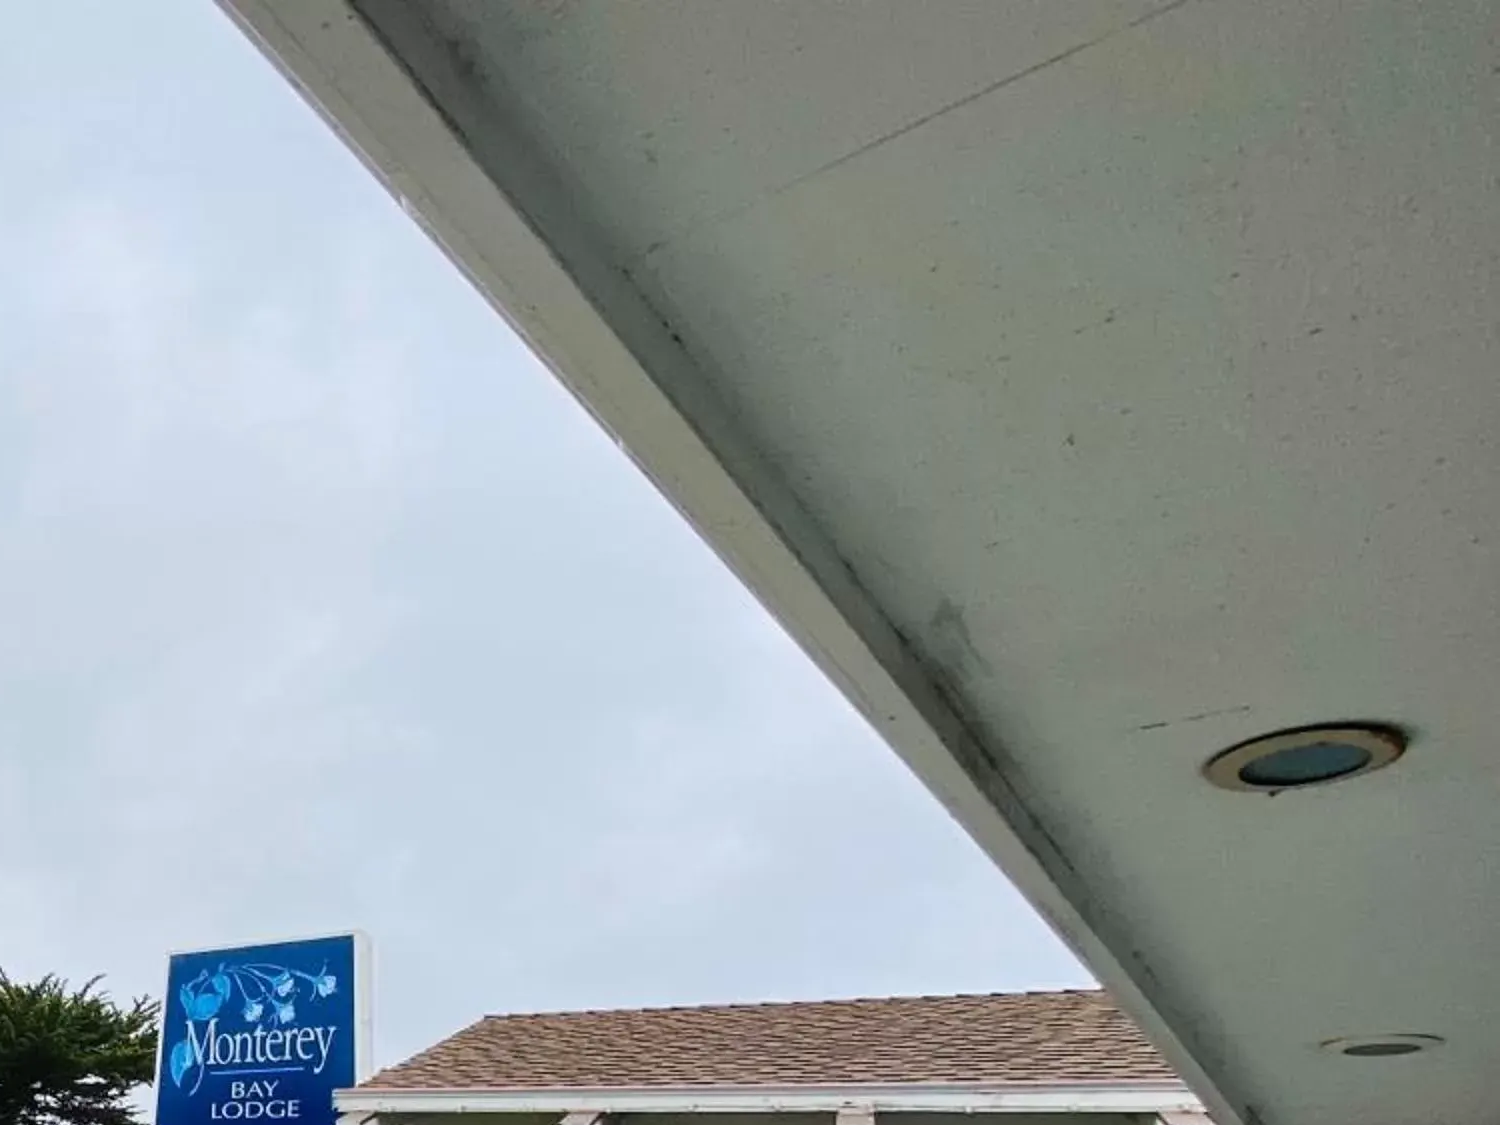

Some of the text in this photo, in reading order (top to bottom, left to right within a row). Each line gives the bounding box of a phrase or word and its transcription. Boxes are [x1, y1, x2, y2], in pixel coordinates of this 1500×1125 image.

[185, 1018, 337, 1074] Monterey
[231, 1080, 279, 1099] BAY
[211, 1100, 302, 1120] LODGE
